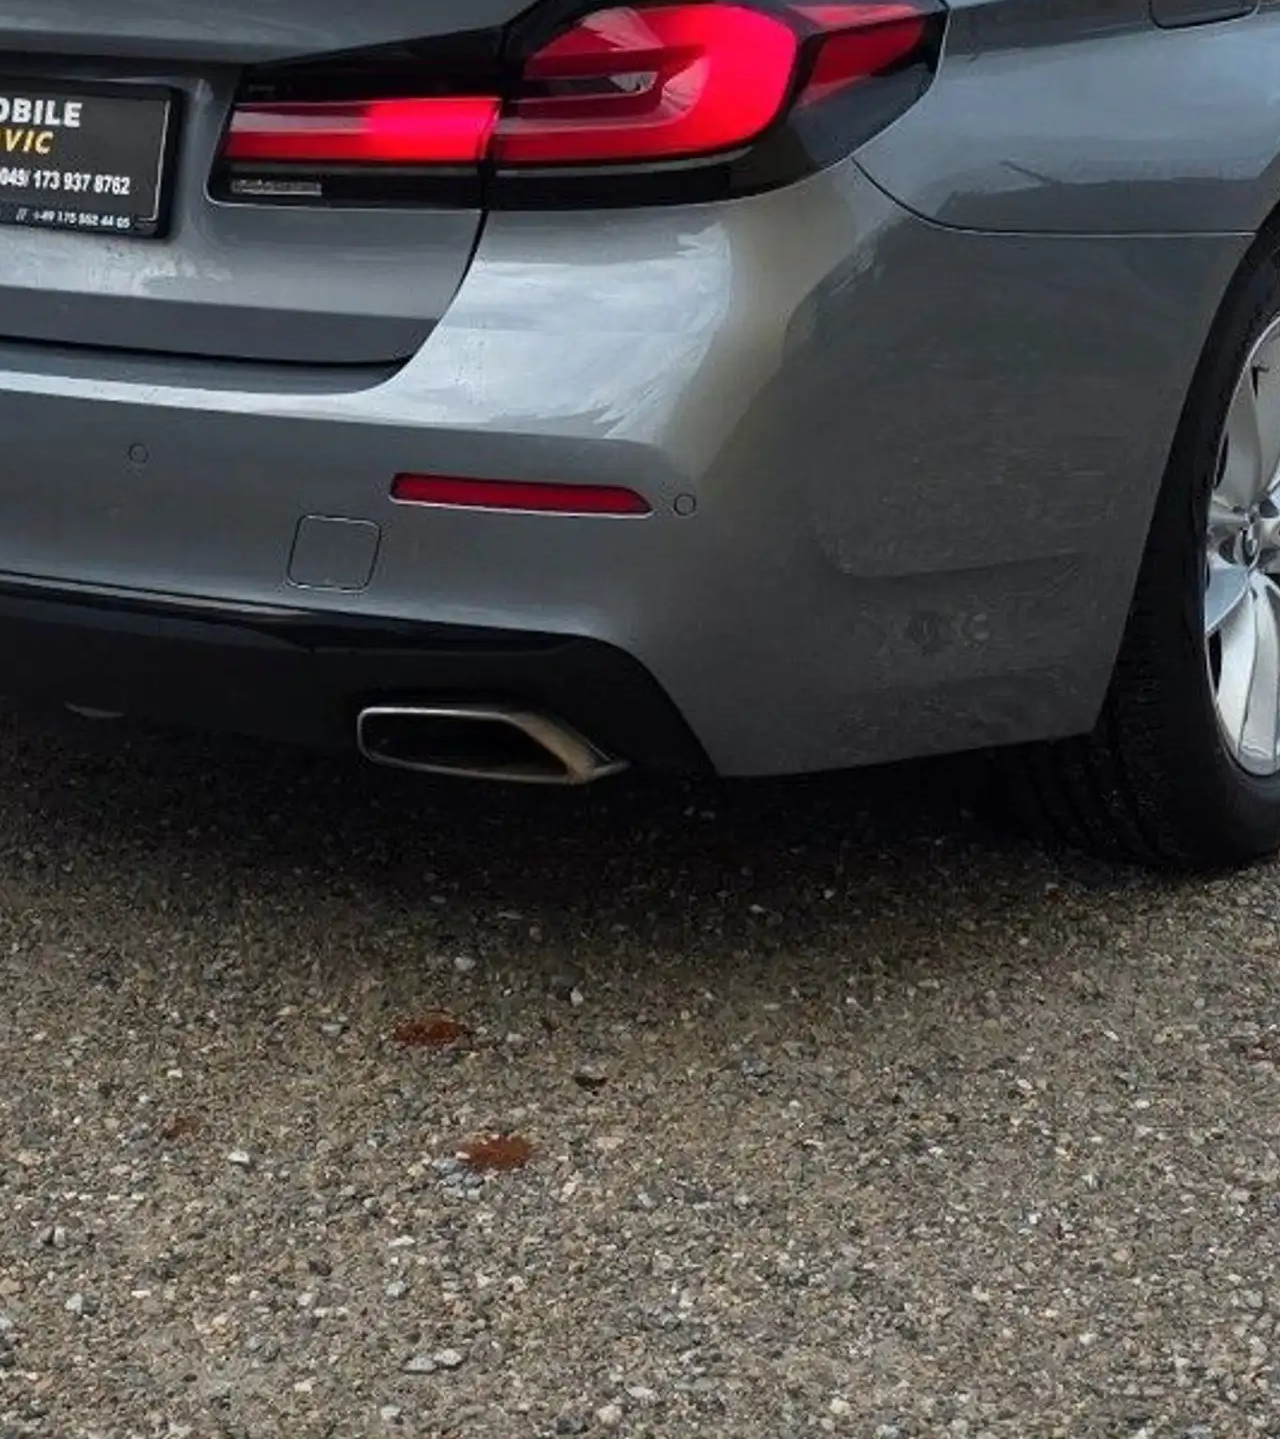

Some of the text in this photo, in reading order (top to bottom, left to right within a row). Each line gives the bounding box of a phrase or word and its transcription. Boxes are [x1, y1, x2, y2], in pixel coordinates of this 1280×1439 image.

[33, 168, 61, 189] 173
[63, 171, 91, 193] 937
[94, 174, 131, 195] 8762
